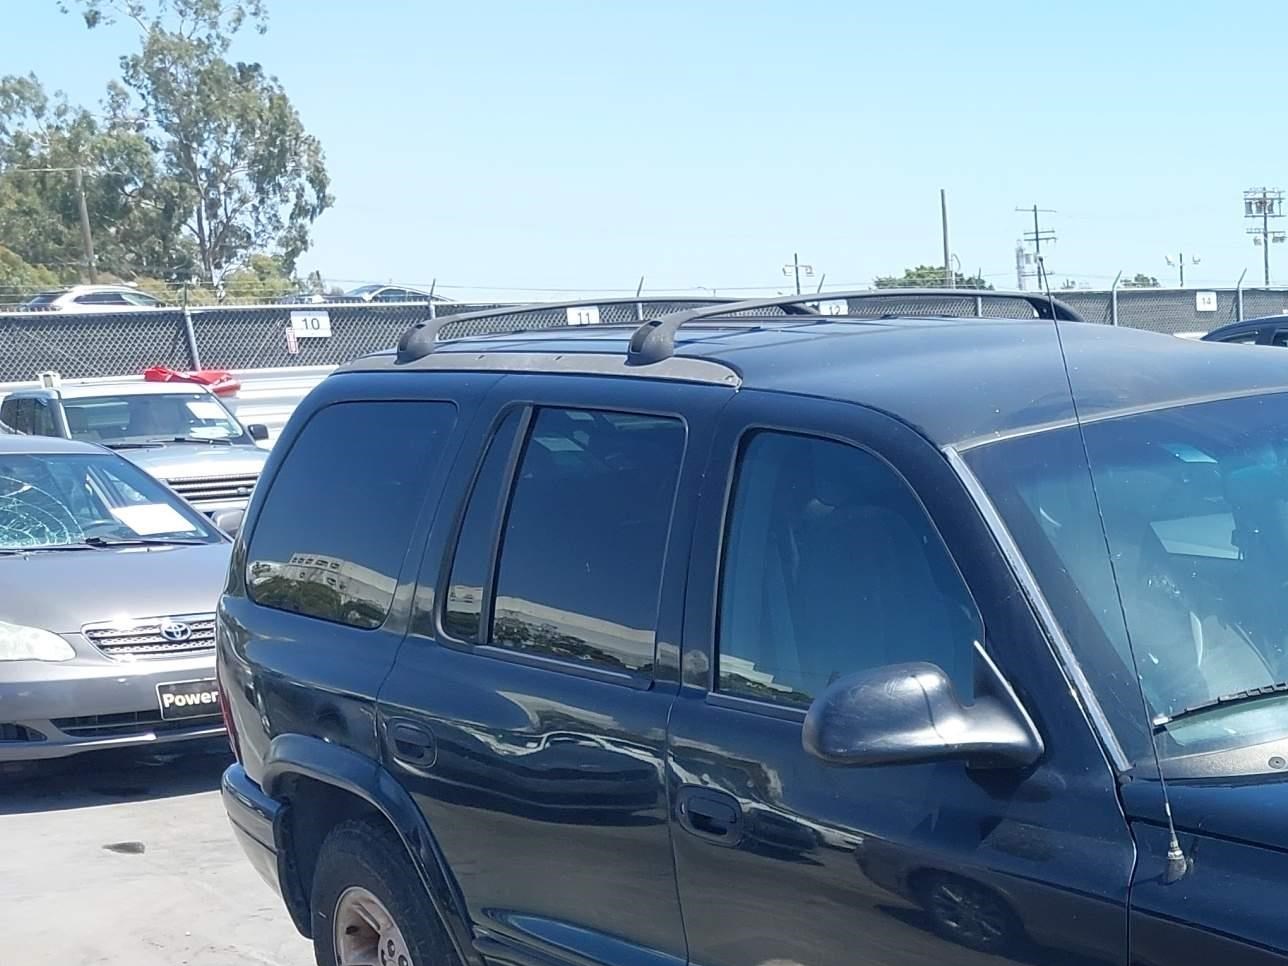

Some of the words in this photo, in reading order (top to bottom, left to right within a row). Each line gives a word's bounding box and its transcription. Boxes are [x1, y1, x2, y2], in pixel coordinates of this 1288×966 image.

[302, 318, 320, 330] 10
[577, 311, 590, 324] 11
[162, 691, 219, 708] Power
